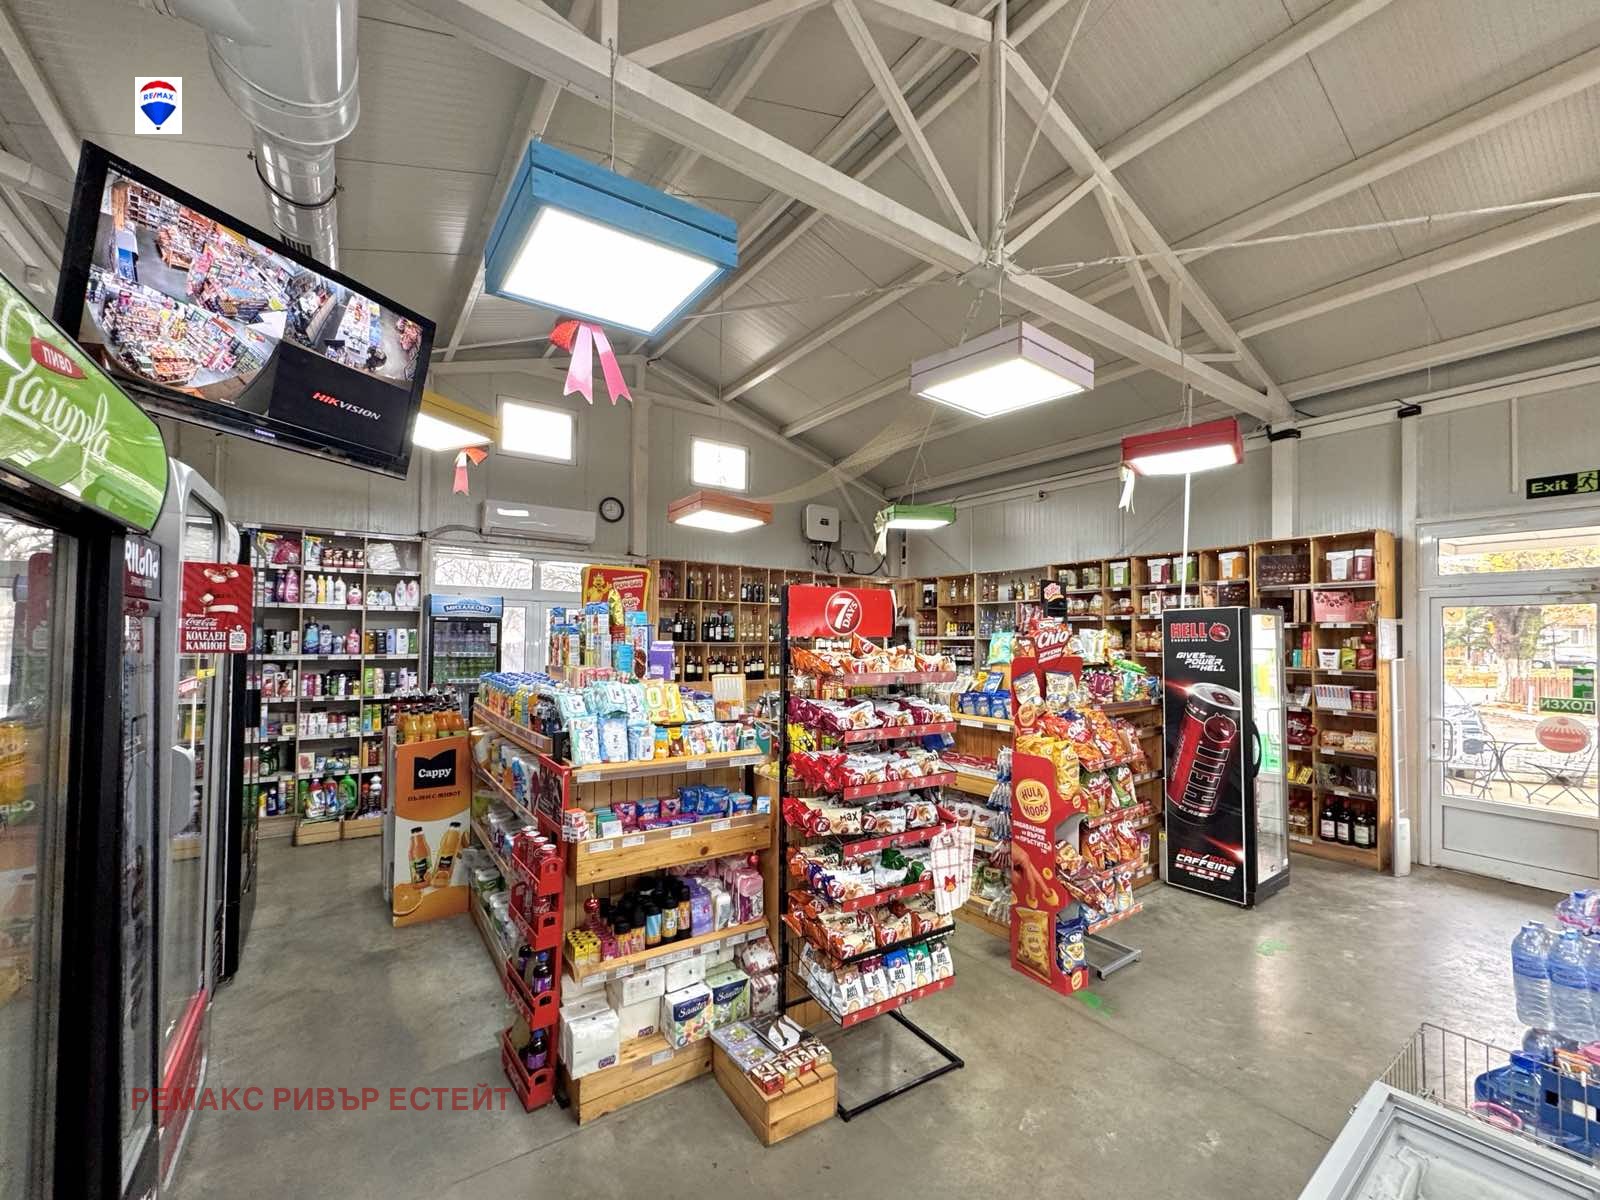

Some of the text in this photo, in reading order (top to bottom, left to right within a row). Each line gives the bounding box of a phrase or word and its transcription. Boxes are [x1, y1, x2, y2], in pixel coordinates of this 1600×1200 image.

[42, 345, 73, 375] ПИВО
[312, 392, 382, 421] HIKVISION
[1531, 480, 1569, 494] Exit
[832, 598, 858, 629] 7 DAYS
[186, 631, 226, 641] КОЛЕДЕН
[1170, 622, 1207, 639] HELL
[186, 641, 226, 651] КАМИОН
[1037, 630, 1070, 649] Chio
[1540, 699, 1594, 713] ИЗХОД
[418, 767, 452, 779] Cappy
[1182, 745, 1230, 808] HELL
[1021, 787, 1043, 800] HULA
[1023, 803, 1049, 816] HOOPS
[1176, 853, 1237, 874] CAFFEINE
